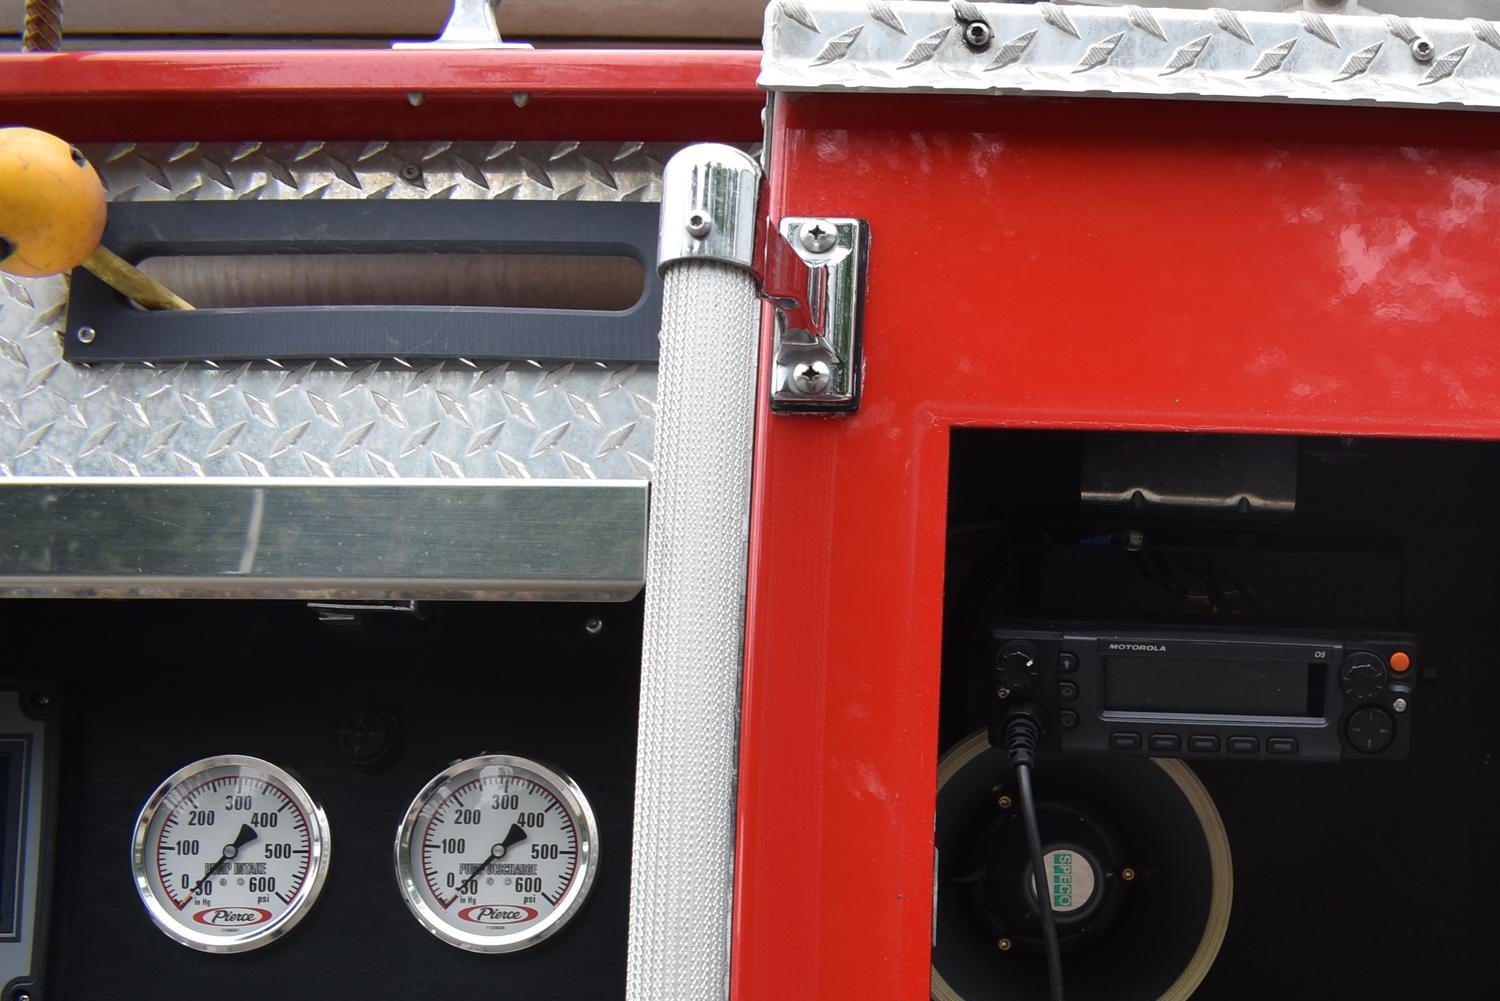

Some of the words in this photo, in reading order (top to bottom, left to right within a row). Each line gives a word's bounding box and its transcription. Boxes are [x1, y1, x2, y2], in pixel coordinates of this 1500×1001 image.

[1109, 643, 1167, 652] MOTOROLA
[225, 795, 252, 811] 300
[491, 794, 519, 810] 300
[188, 810, 215, 826] 200
[251, 812, 278, 828] 400
[454, 809, 481, 825] 200
[517, 812, 545, 828] 400
[176, 840, 199, 856] 100
[264, 843, 292, 859] 500
[441, 838, 465, 854] 100
[531, 843, 558, 859] 500
[181, 874, 190, 889] 0
[249, 877, 276, 893] 600
[446, 872, 455, 888] 0
[515, 877, 542, 893] 600
[1057, 853, 1073, 907] SPECO
[258, 894, 270, 904] psi
[523, 894, 536, 905] psi
[211, 909, 257, 923] Pierce
[477, 906, 522, 920] Pierce
